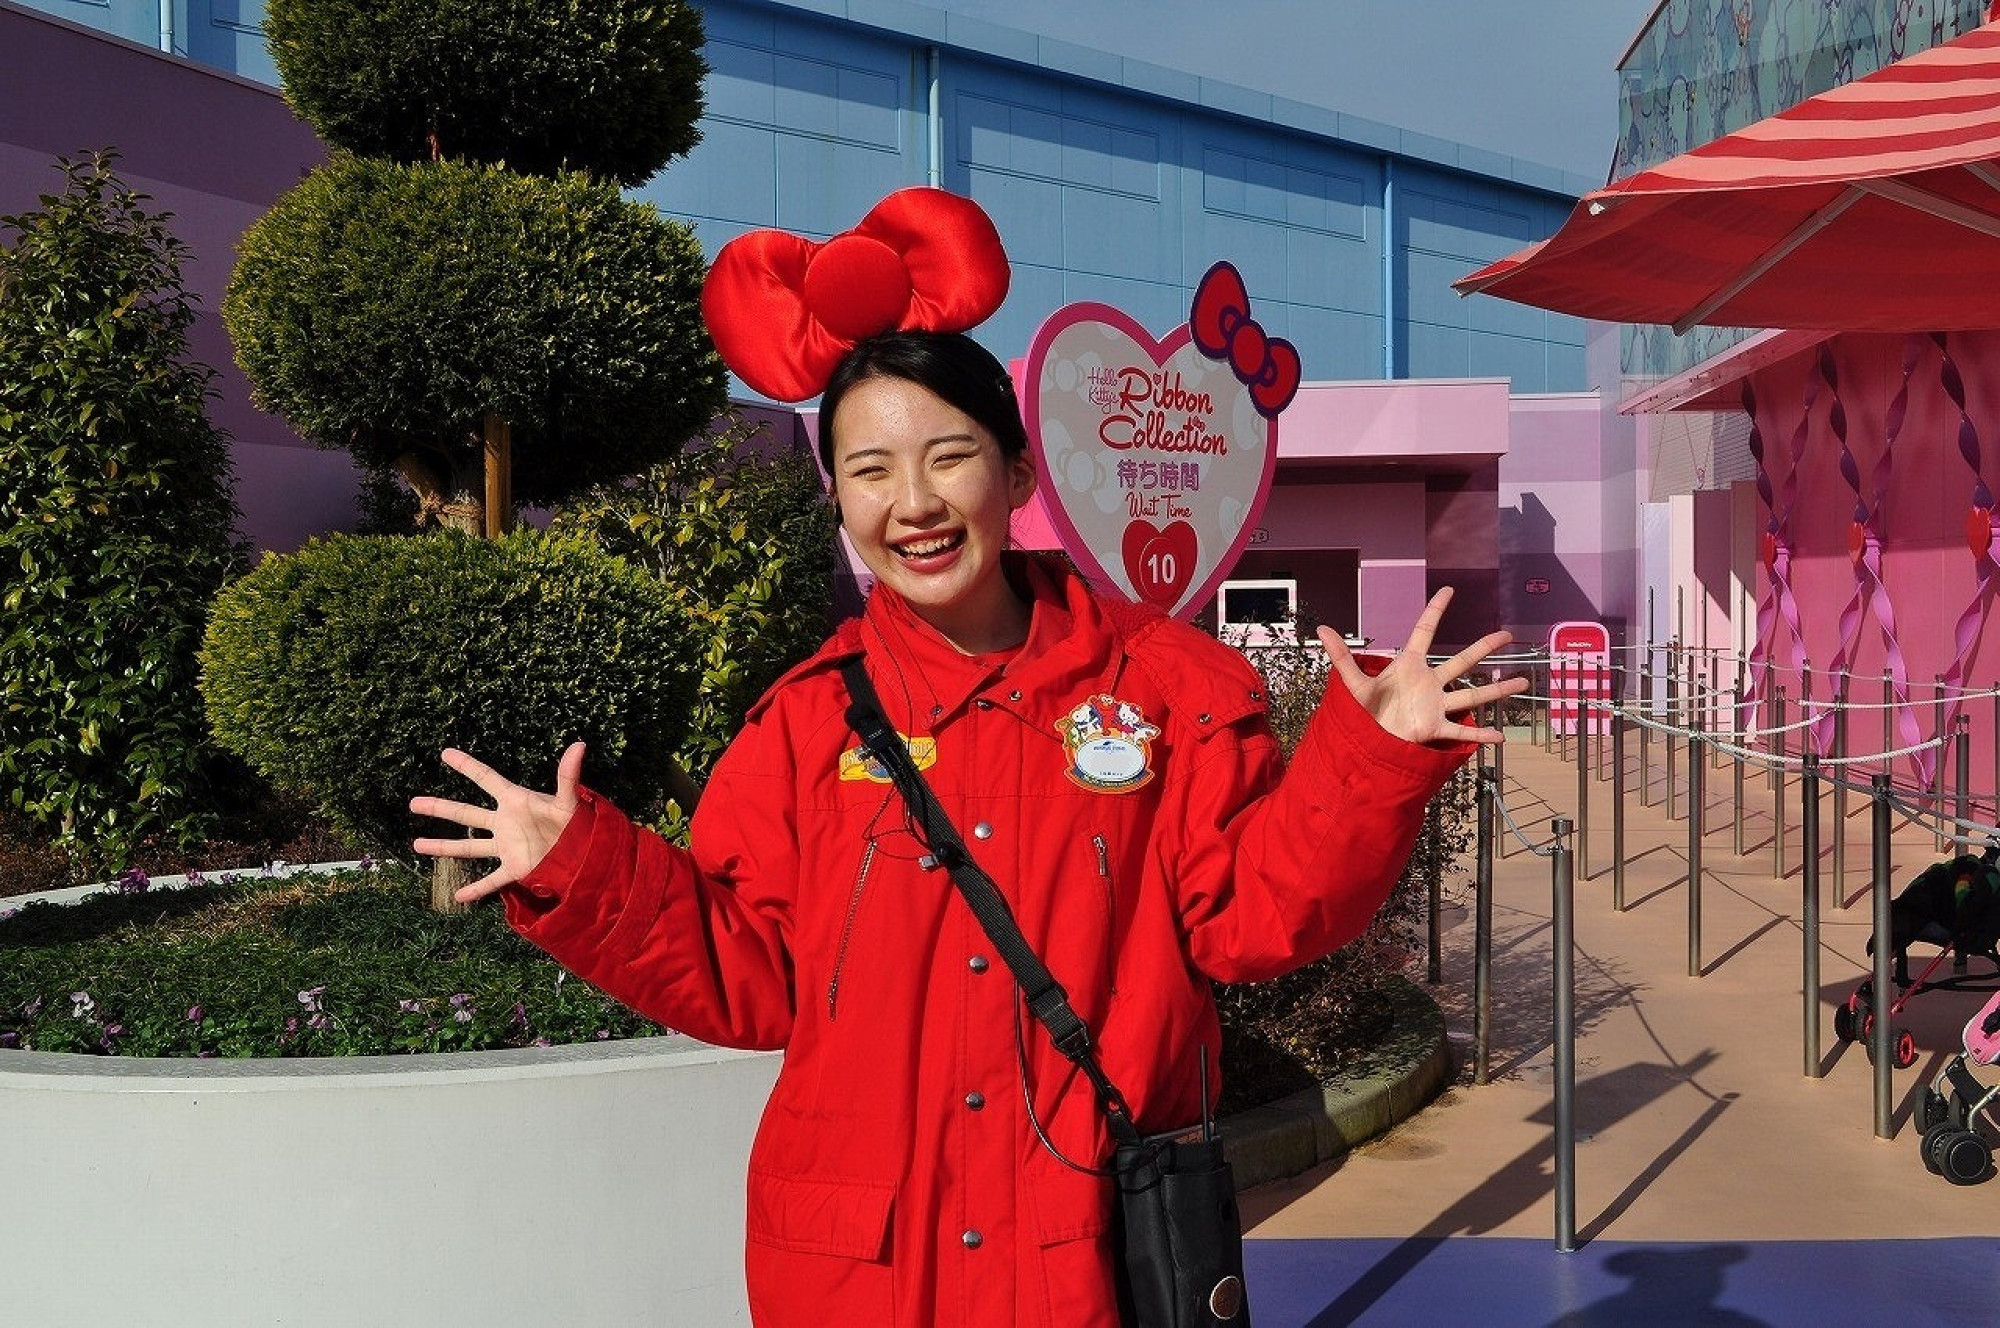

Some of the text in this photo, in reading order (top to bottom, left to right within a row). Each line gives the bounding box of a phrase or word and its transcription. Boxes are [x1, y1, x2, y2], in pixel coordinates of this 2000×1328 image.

[1087, 366, 1117, 387] Hello
[1118, 366, 1213, 417] Ribbon
[1099, 410, 1228, 456] Collection
[1117, 459, 1199, 491] 待ち時間
[1125, 491, 1193, 519] Wait Time
[1148, 553, 1176, 584] 10
